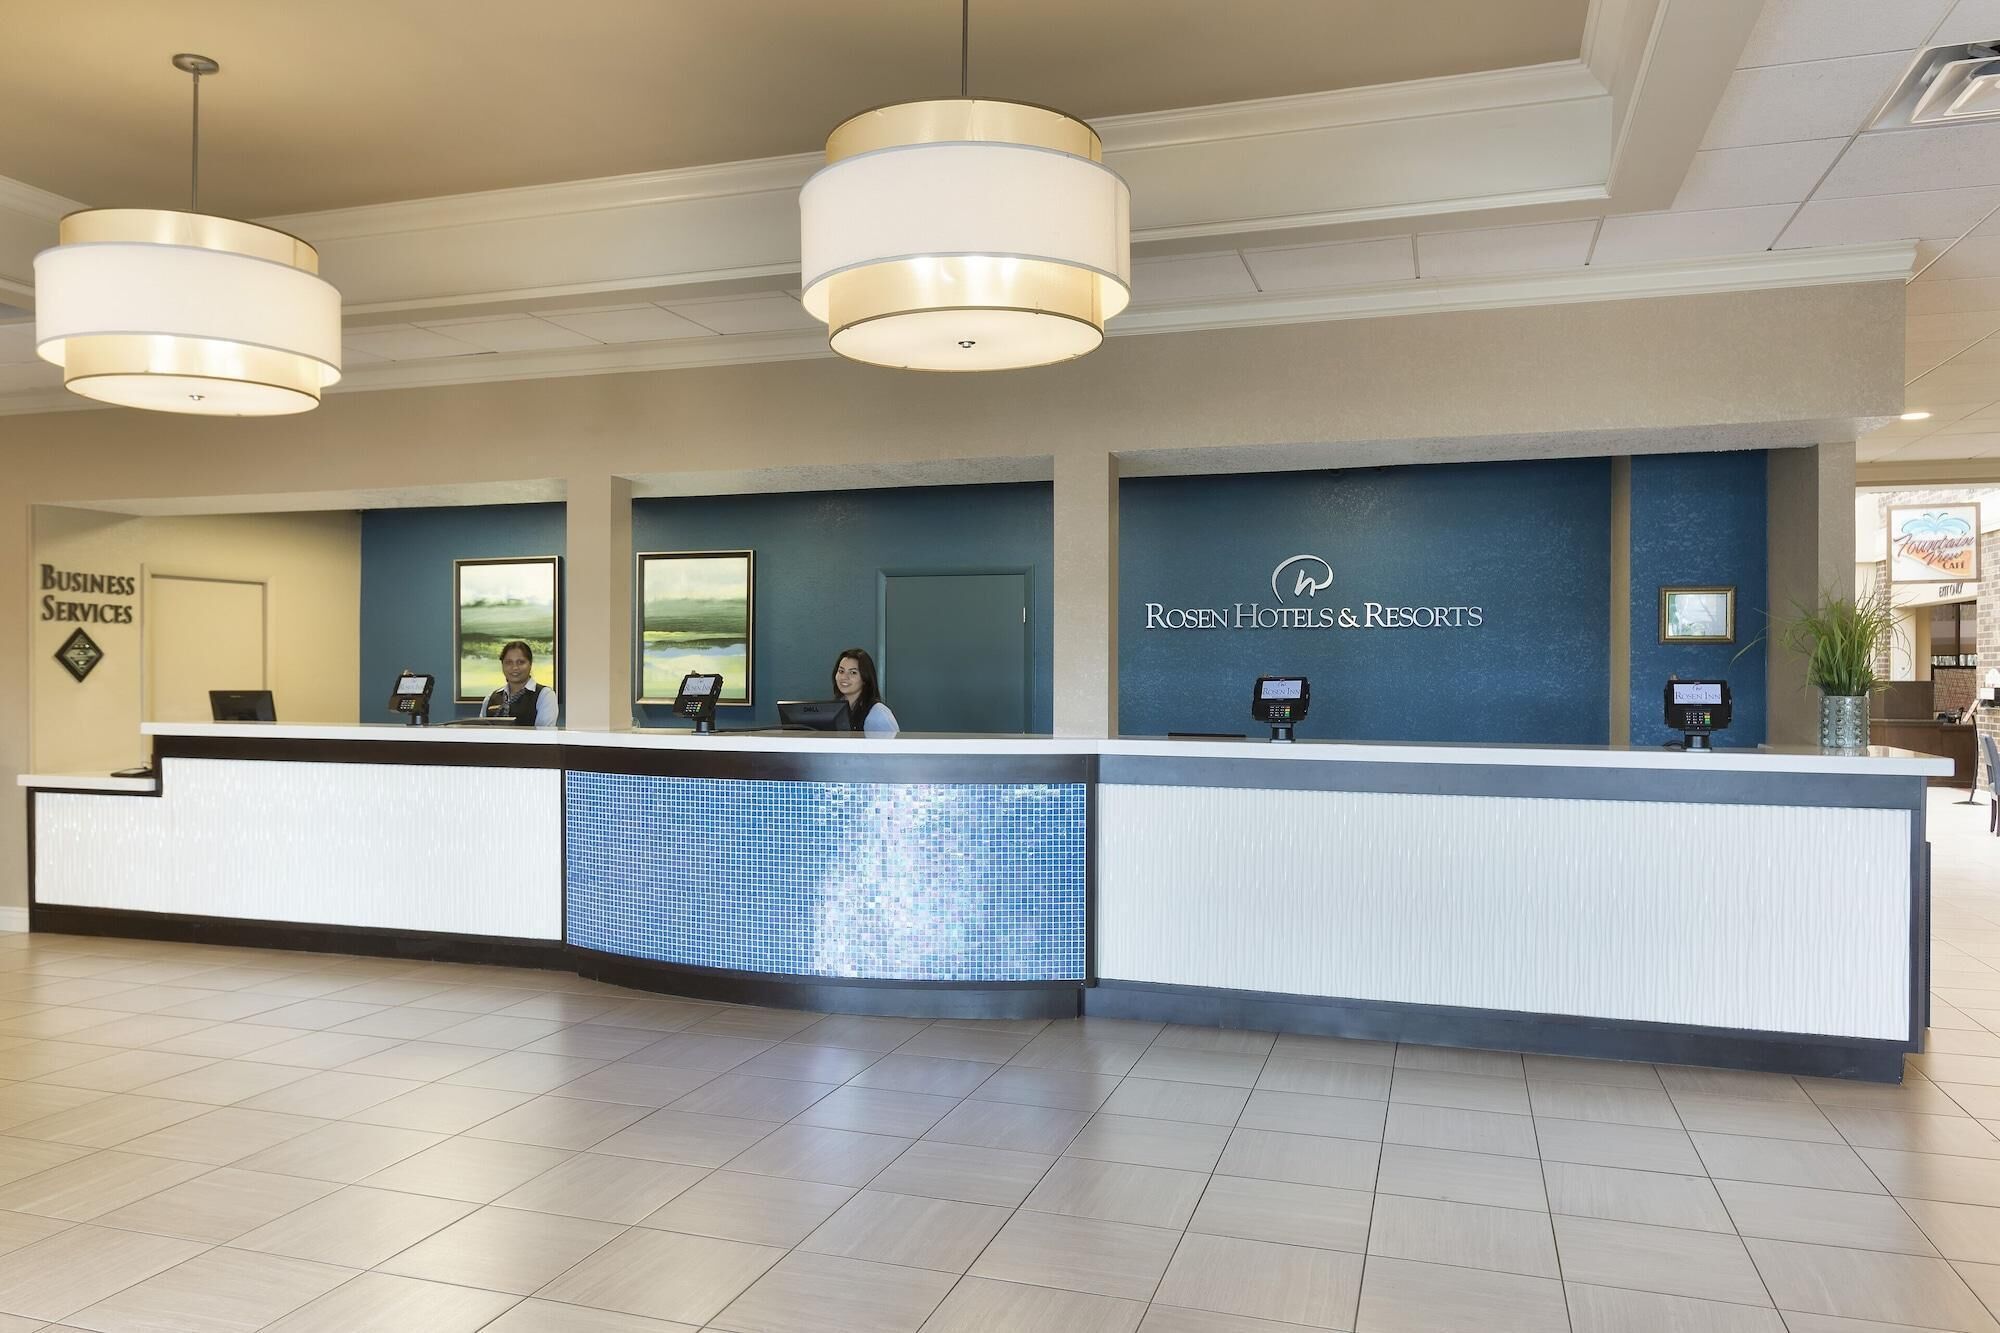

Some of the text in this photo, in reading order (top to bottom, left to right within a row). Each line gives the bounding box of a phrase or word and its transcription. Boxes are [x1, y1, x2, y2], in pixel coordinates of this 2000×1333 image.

[1893, 530, 1975, 557] Fountain
[41, 563, 135, 595] BUSINESS
[42, 595, 132, 623] SERVICES
[1145, 602, 1483, 629] ROSEN HOTELS & RESORTS
[1675, 691, 1702, 700] ROSEN
